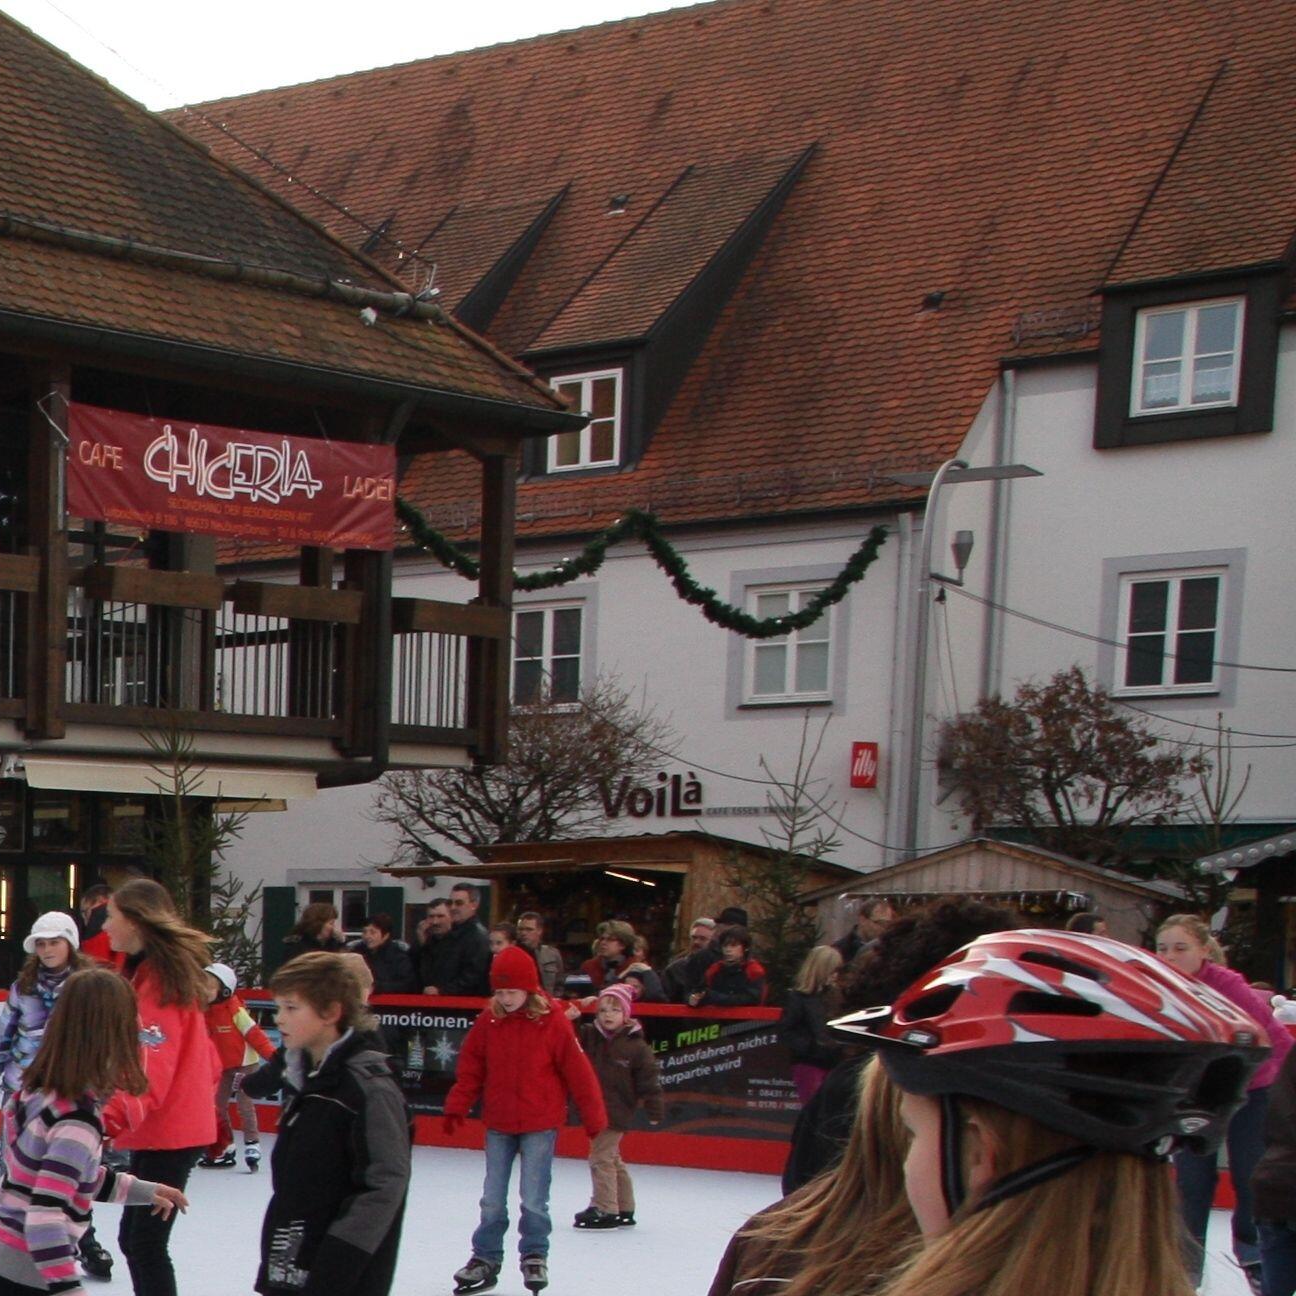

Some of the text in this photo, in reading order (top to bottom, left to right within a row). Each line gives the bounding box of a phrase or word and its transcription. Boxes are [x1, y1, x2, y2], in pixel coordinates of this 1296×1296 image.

[79, 439, 124, 472] CAFE
[853, 749, 876, 782] illy
[666, 1043, 734, 1069] Autofahren
[737, 1034, 768, 1051] nicht
[714, 1056, 742, 1073] wird
